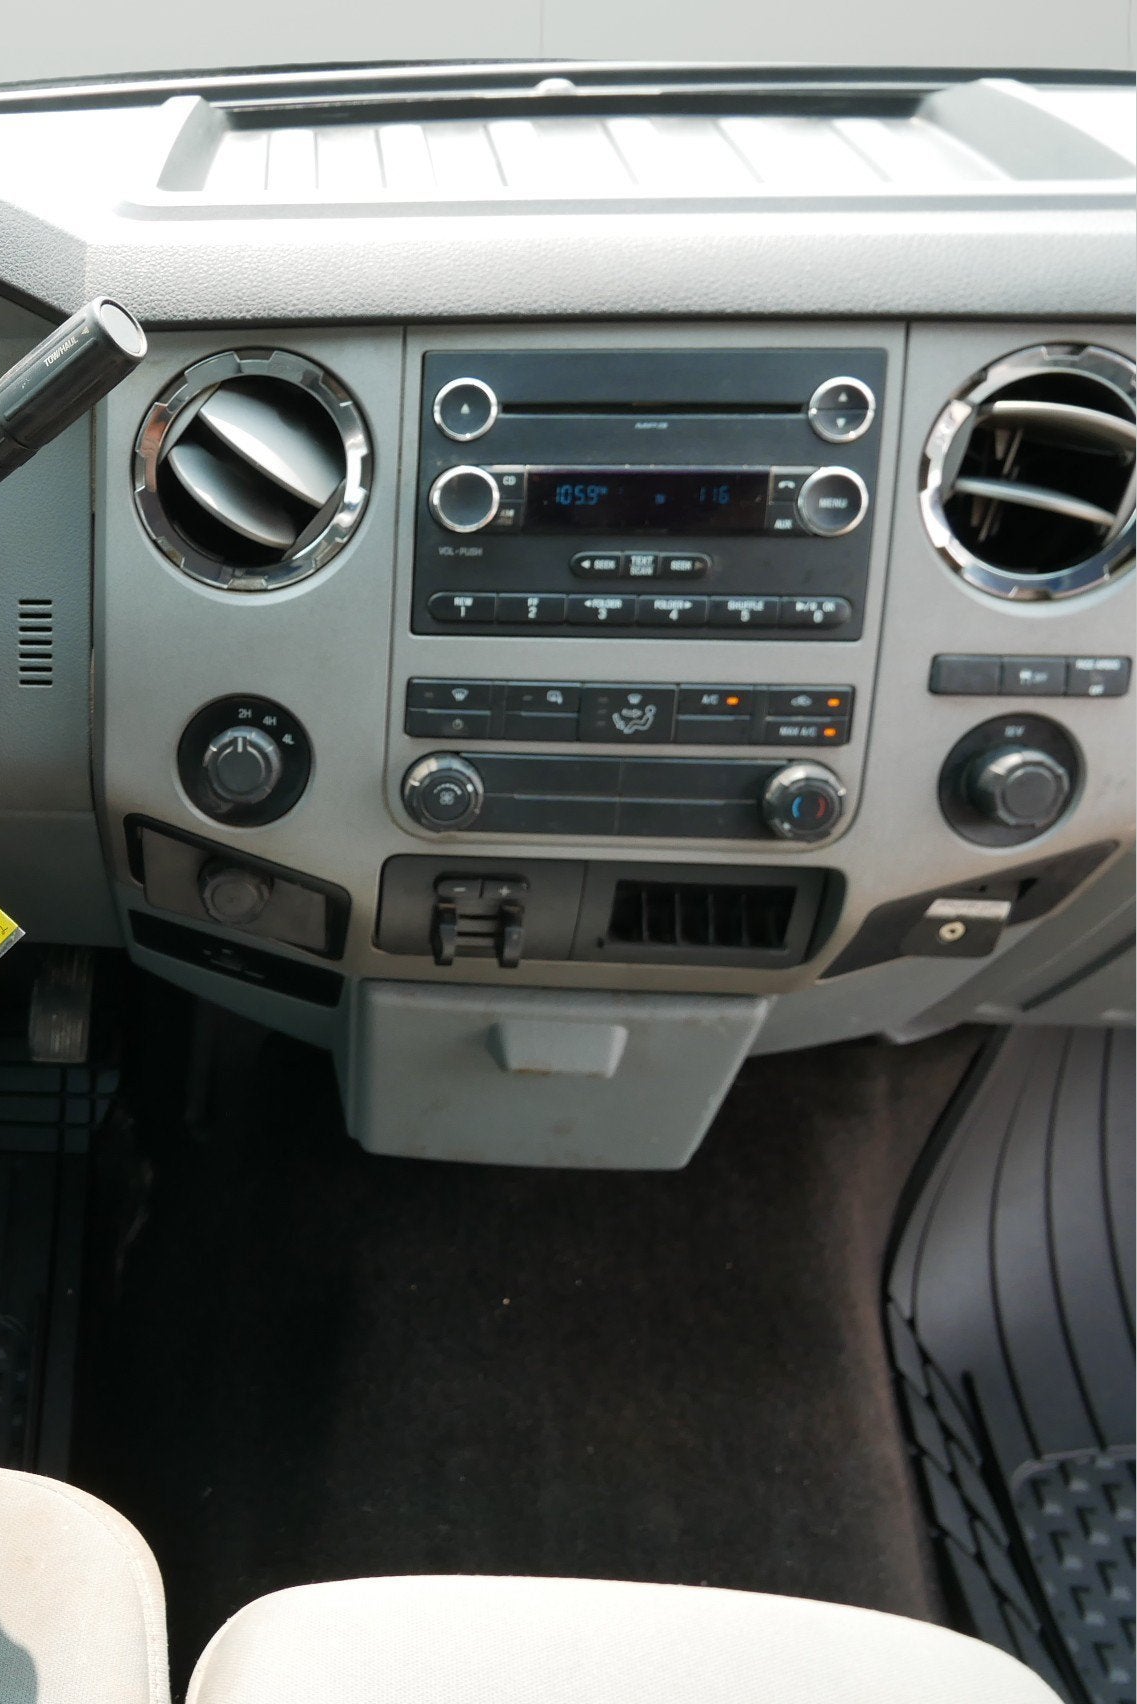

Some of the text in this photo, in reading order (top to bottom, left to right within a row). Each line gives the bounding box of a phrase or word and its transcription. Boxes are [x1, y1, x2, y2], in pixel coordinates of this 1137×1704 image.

[43, 336, 79, 367] TOW/HAUL
[818, 497, 848, 509] MENU
[774, 519, 793, 530] AUX
[460, 607, 466, 618] 1
[528, 606, 537, 619] 2
[238, 708, 252, 719] 2H
[262, 716, 277, 727] 4H
[281, 733, 295, 745] 4L
